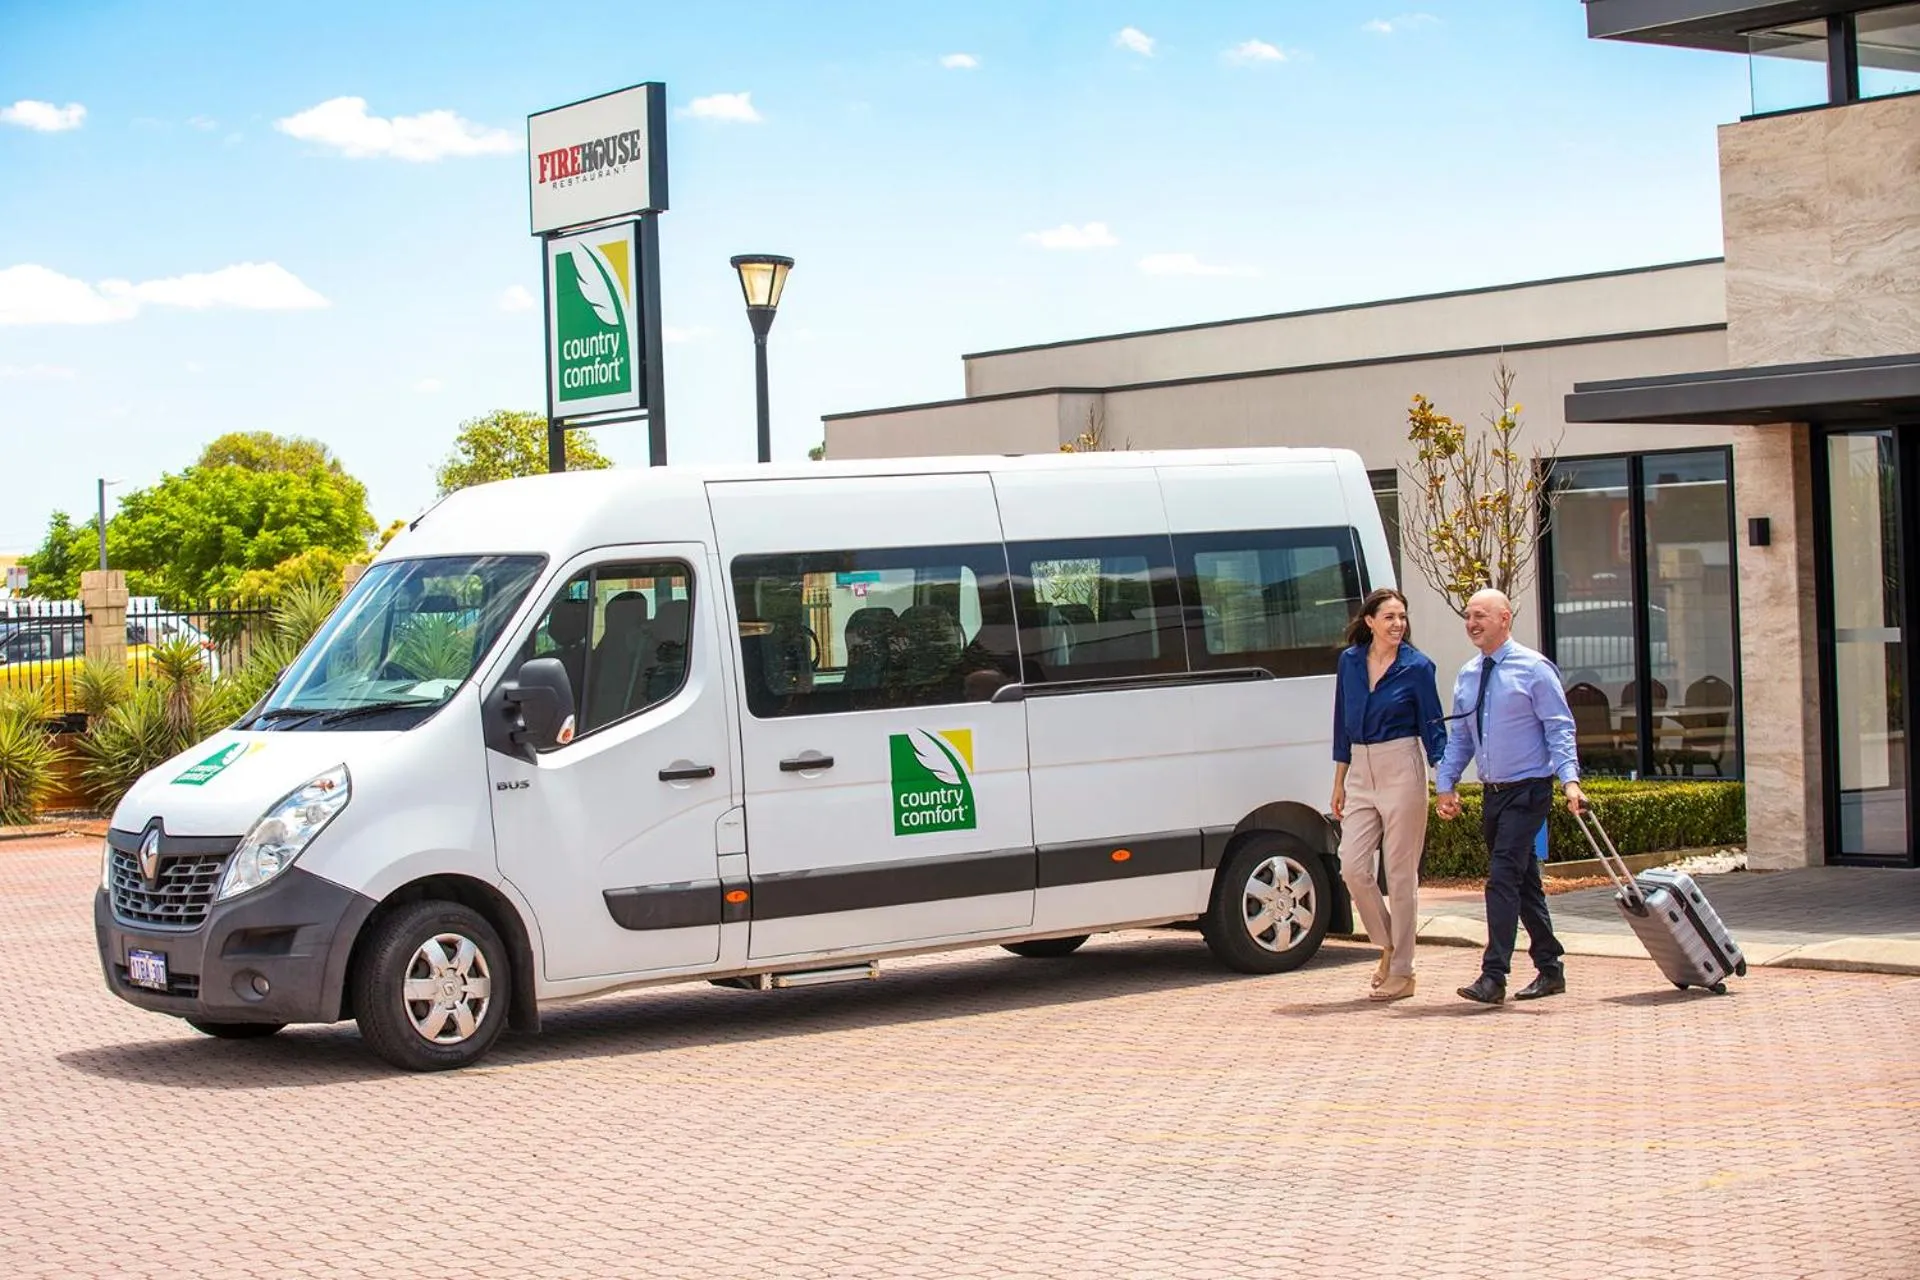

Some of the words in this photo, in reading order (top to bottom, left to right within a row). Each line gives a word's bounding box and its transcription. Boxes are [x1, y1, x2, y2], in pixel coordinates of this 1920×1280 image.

[538, 129, 641, 184] FIREHOUSE
[552, 165, 627, 189] RESTAURANT
[563, 331, 620, 361] country
[564, 357, 621, 388] comfort
[496, 780, 530, 790] BUS
[900, 788, 964, 807] country
[901, 805, 965, 827] comfort
